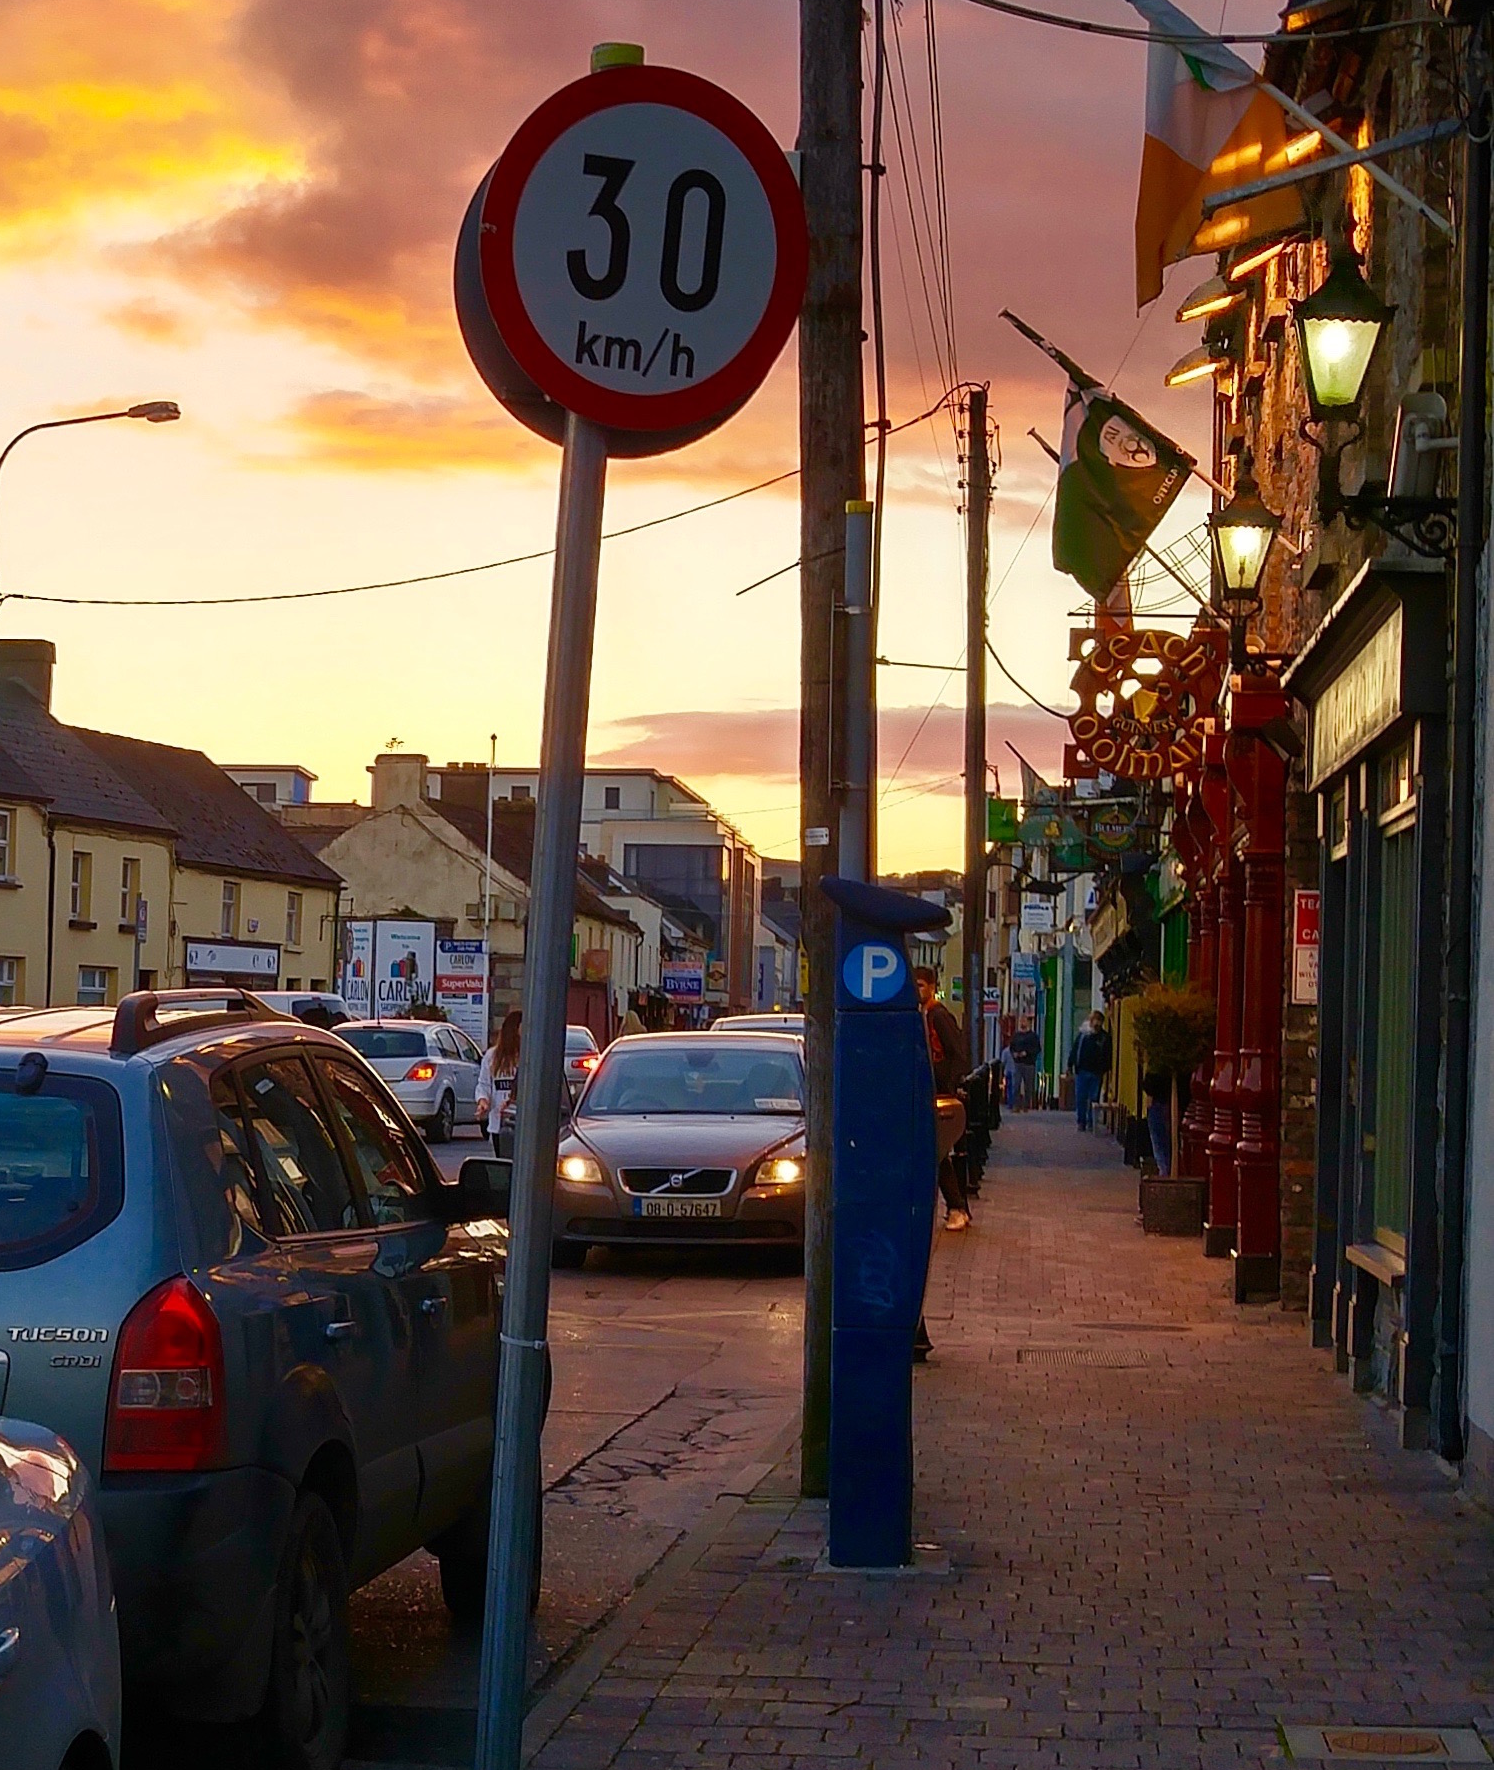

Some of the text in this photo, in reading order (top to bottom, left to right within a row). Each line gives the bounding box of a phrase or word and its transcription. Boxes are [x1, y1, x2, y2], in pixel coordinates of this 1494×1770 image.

[567, 153, 727, 312] 30
[575, 321, 695, 378] km/h
[1113, 717, 1176, 734] GUINNESS
[189, 950, 199, 966] 62
[267, 955, 276, 970] 62
[666, 979, 700, 989] BYRNE
[8, 1326, 109, 1342] TUCSON
